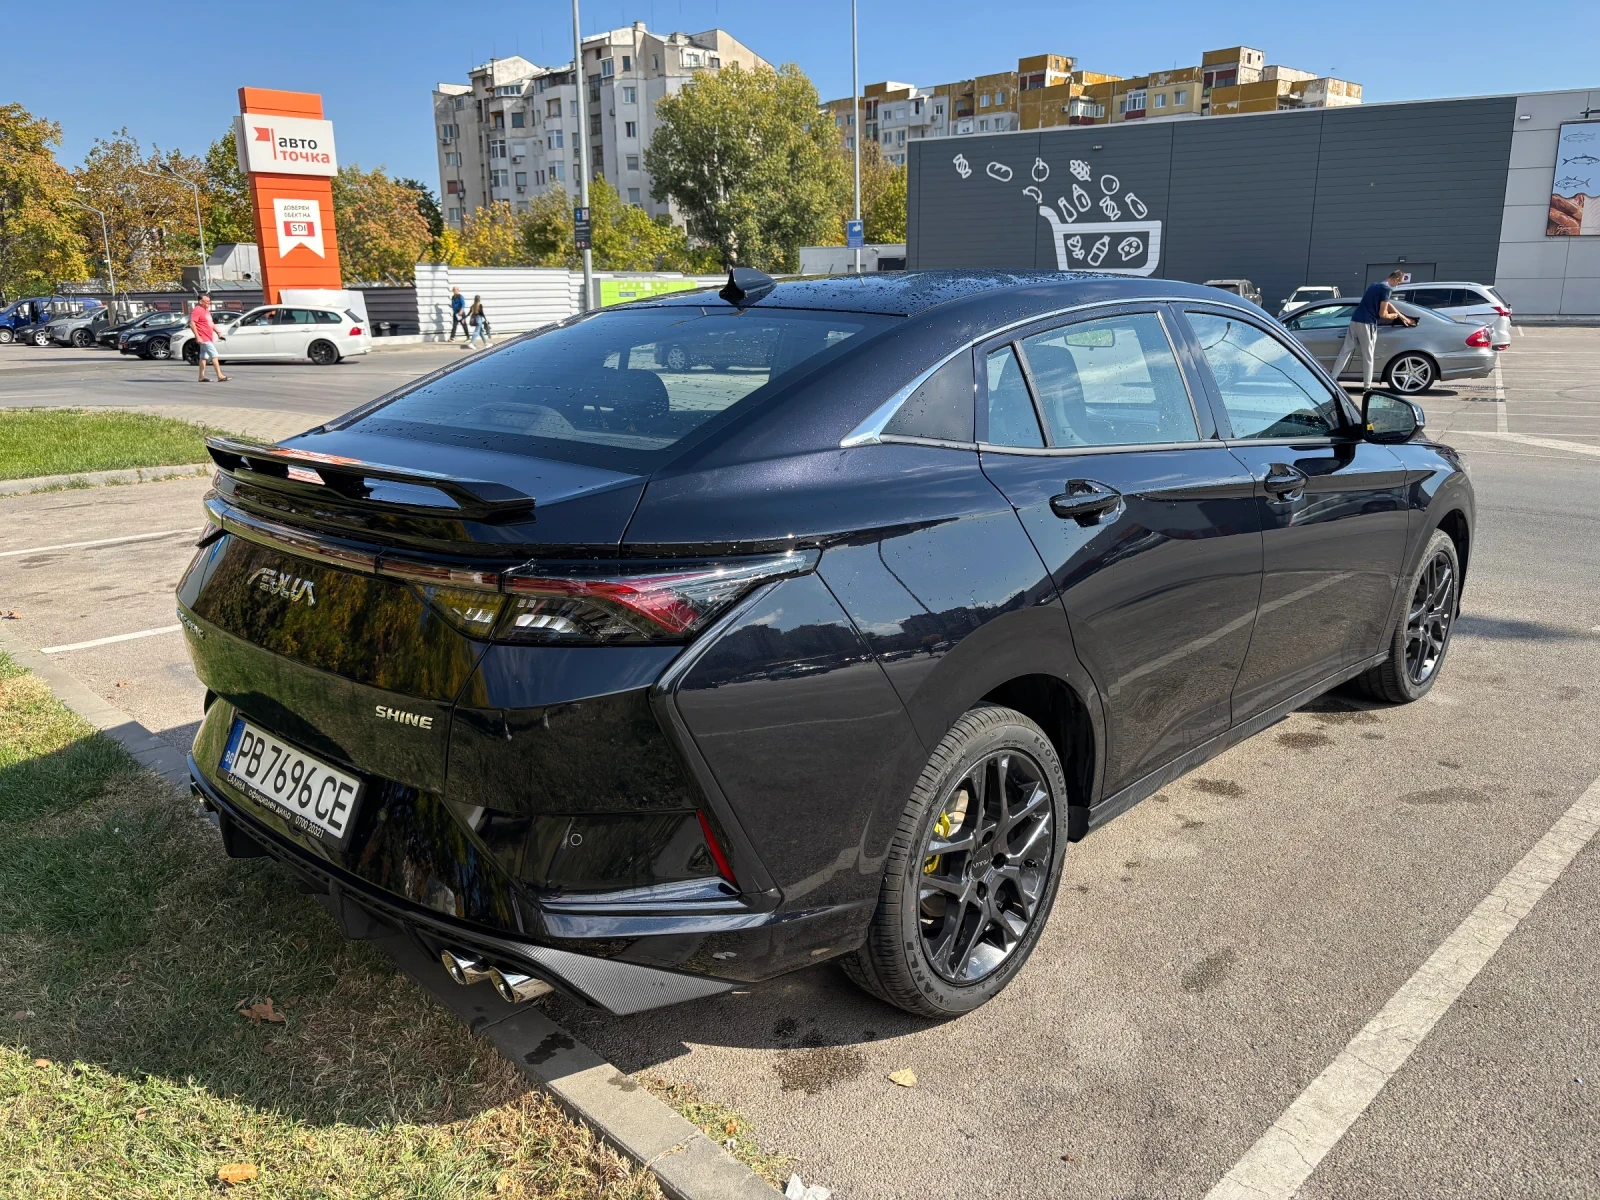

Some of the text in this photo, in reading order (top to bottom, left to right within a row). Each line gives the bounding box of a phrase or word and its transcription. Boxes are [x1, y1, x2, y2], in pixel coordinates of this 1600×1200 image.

[278, 137, 318, 150] авто
[280, 150, 331, 164] точка
[292, 224, 307, 232] SDI
[375, 704, 434, 730] SHINE
[225, 751, 235, 764] BG
